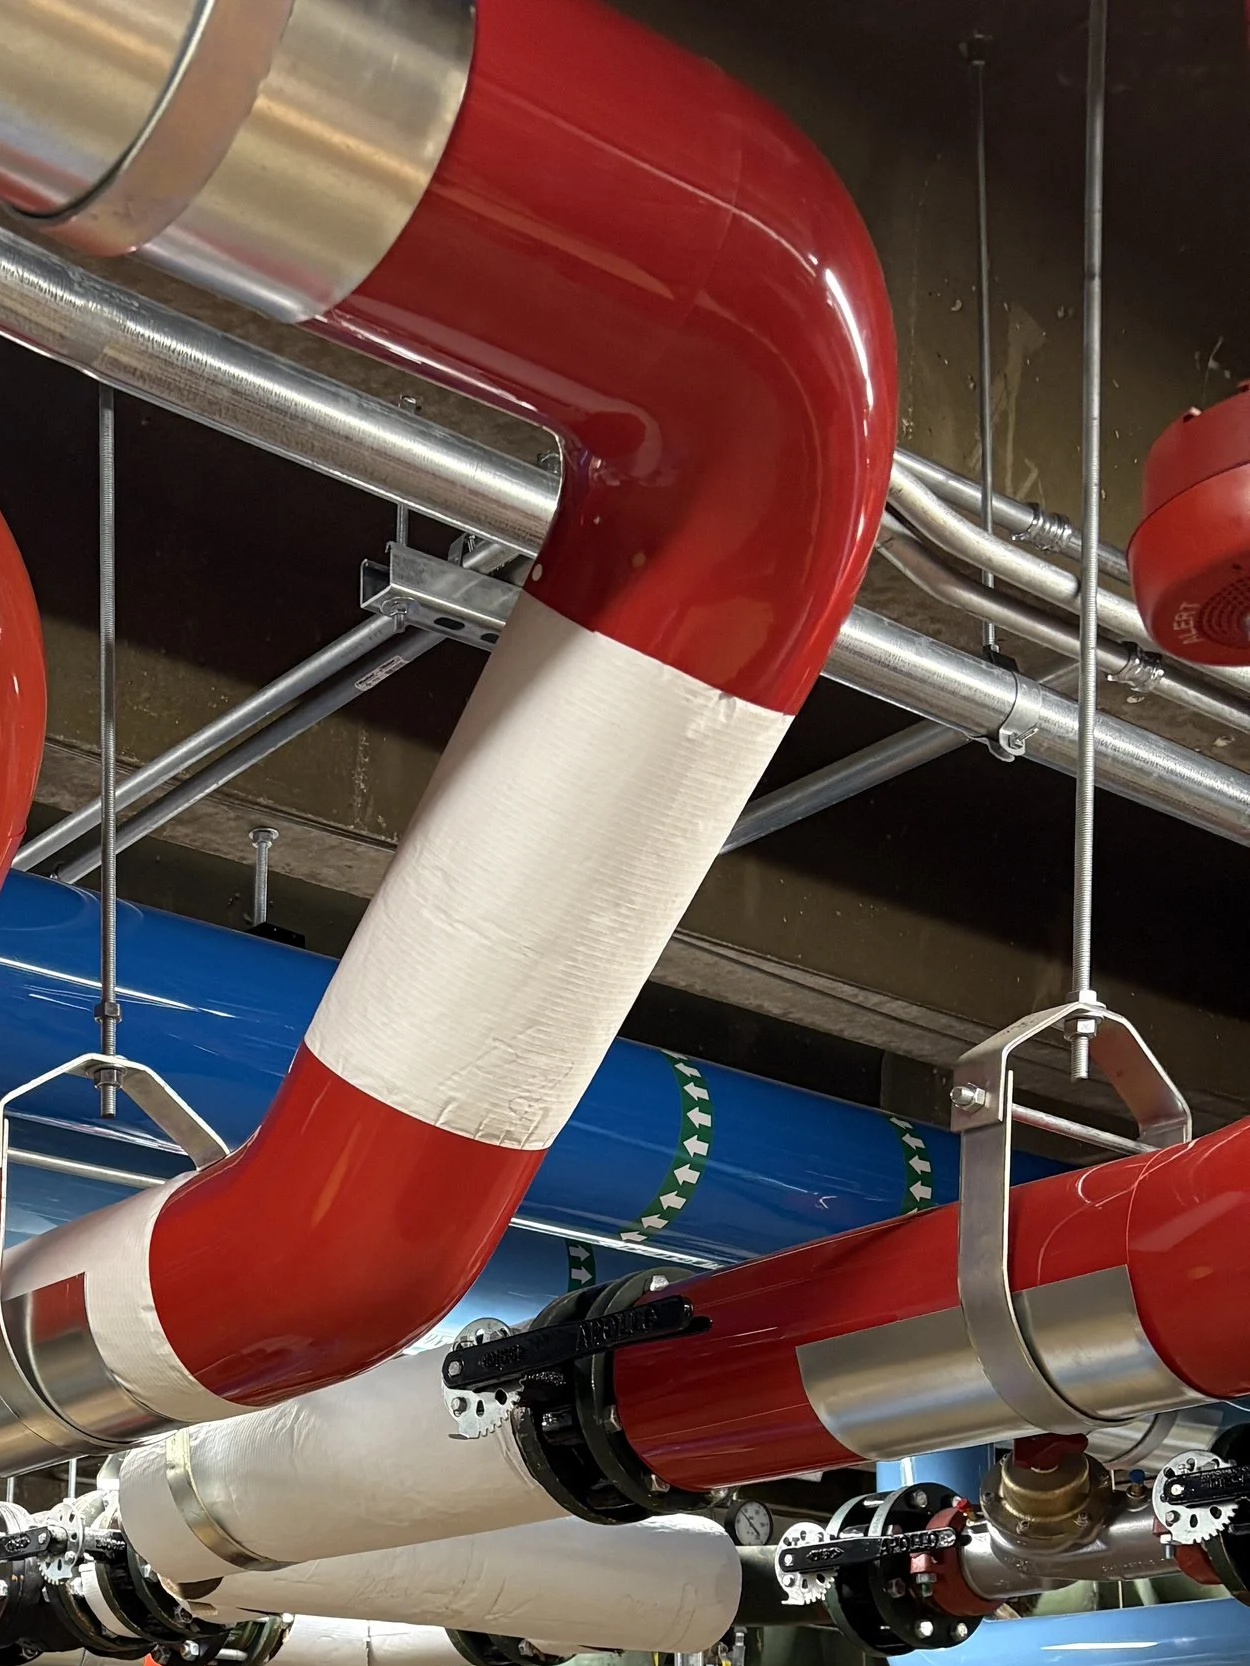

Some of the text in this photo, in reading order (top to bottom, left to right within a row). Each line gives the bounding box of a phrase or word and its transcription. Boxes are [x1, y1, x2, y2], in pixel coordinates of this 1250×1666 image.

[1173, 601, 1204, 644] ALERT
[575, 1305, 659, 1351] APOLLO
[881, 1531, 938, 1555] APOLLO
